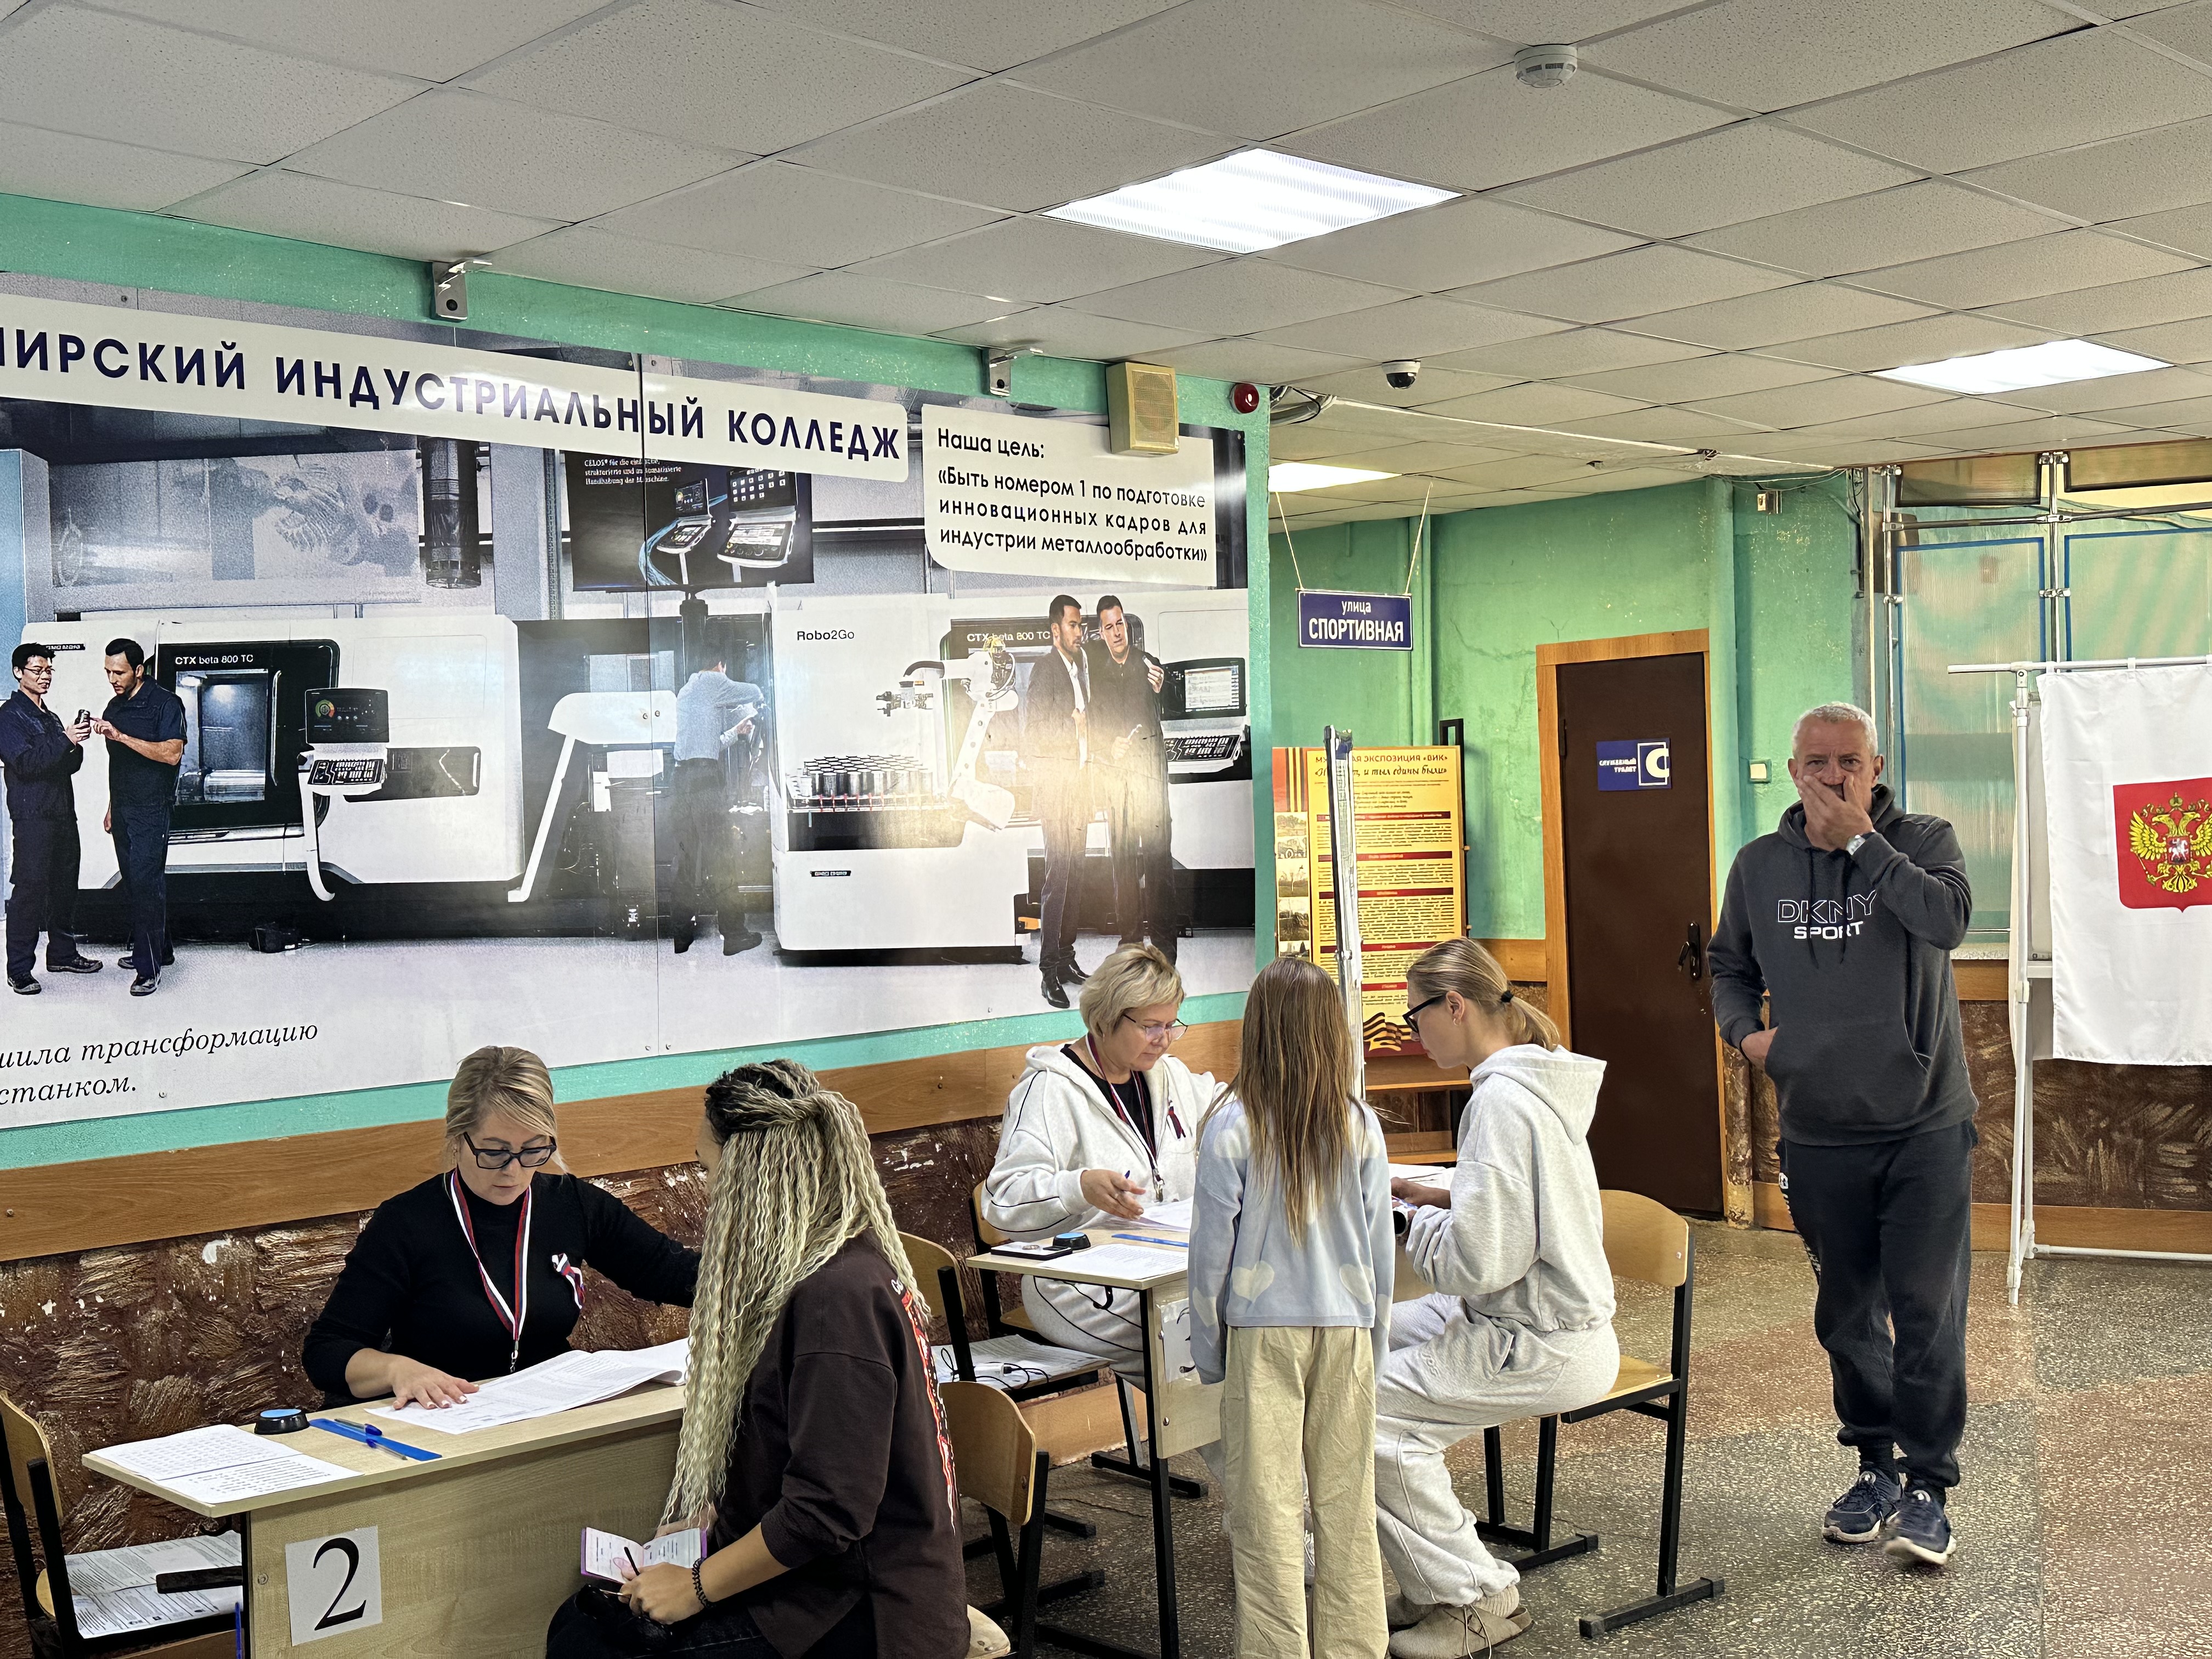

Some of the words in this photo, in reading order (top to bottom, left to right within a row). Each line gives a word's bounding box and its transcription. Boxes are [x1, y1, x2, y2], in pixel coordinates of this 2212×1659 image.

[276, 356, 703, 438] ИНДУСТРИАЛЬНЫЙ
[728, 410, 900, 461] КОЛЛЕДЖ
[938, 427, 991, 453] Наша
[998, 439, 1044, 458] цель:
[939, 466, 989, 487] «Быть
[995, 475, 1074, 497] номером
[1080, 479, 1085, 497] 1
[1093, 485, 1111, 499] по
[1117, 488, 1205, 507] подготовке
[940, 499, 1097, 526] инновационных
[1105, 514, 1170, 534] кадров
[1178, 521, 1206, 535] для
[940, 529, 1036, 552] индустрии
[1041, 537, 1207, 561] металлообработки»
[1341, 601, 1371, 615] улица
[797, 629, 854, 641] Robo2Go
[1309, 618, 1403, 641] СПОРТИВНАЯ
[175, 657, 196, 665] CTX
[221, 655, 238, 663] 800
[1364, 754, 1420, 763] ЭКСПОЗИЦИЯ
[1778, 889, 1877, 924] DKNY
[1794, 921, 1864, 939] SPORT
[81, 1024, 318, 1064] трансформацию
[0, 1076, 136, 1105] станком.
[313, 1537, 366, 1631] 2
